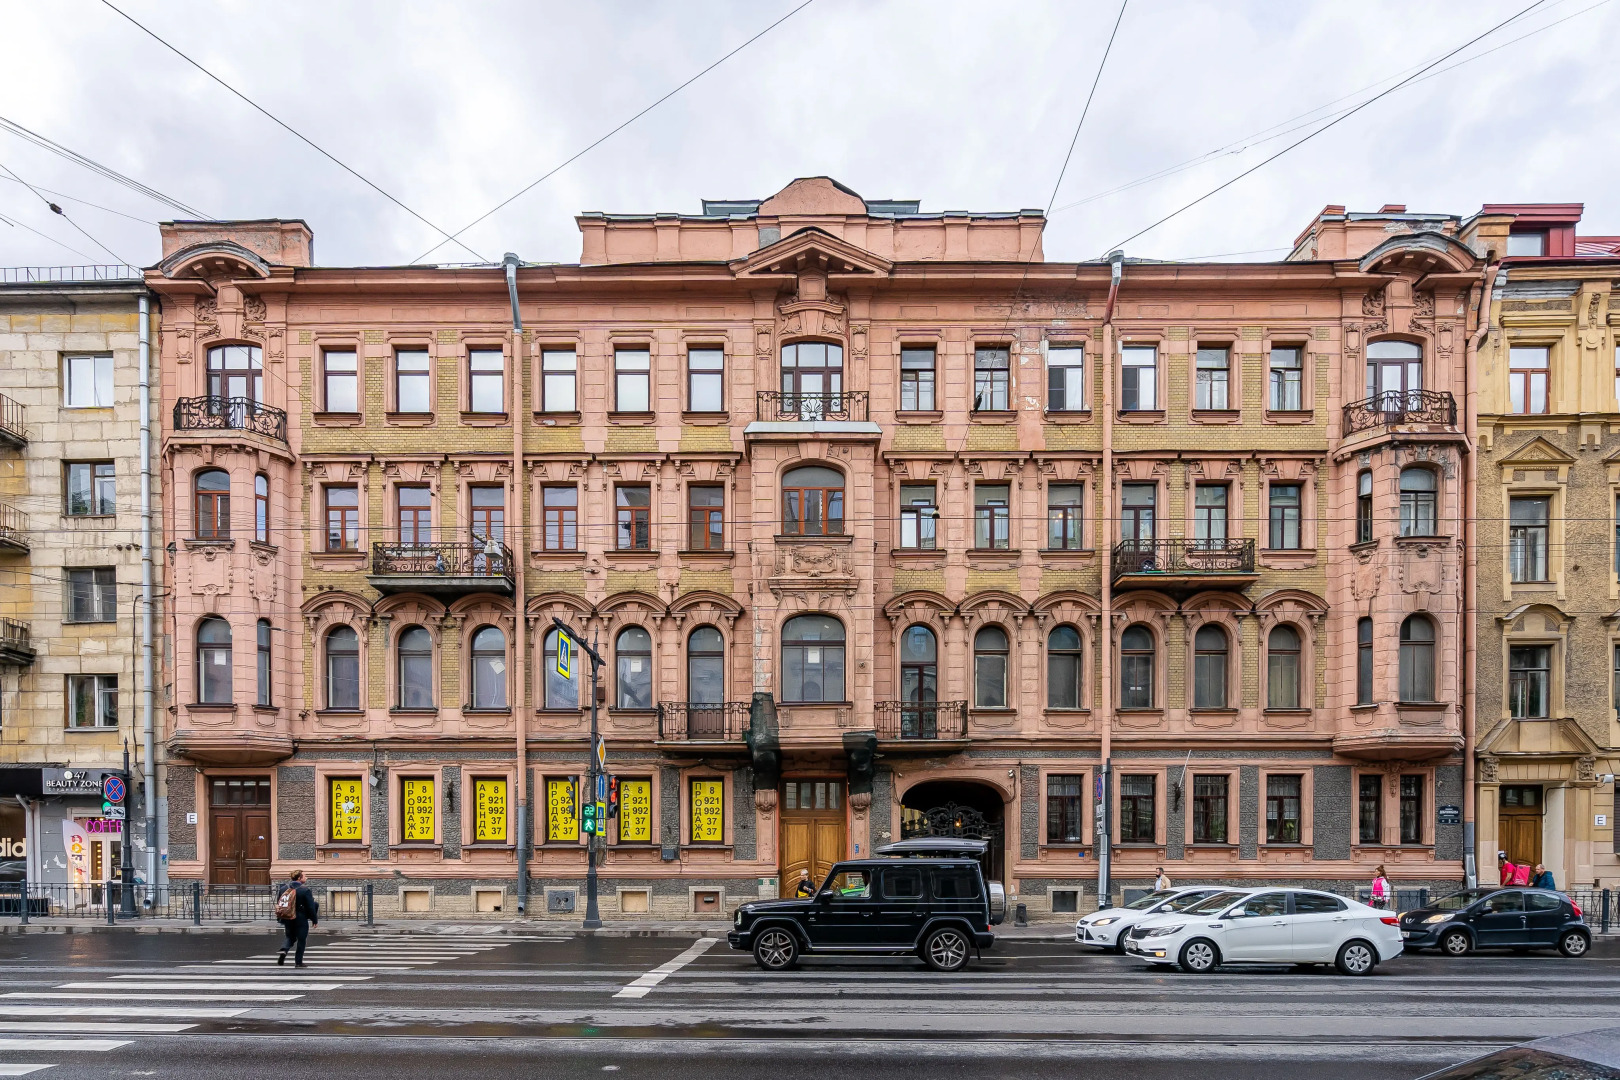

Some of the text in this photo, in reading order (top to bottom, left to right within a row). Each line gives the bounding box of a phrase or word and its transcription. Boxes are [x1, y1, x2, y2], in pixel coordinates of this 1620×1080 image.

[73, 771, 86, 779] 47
[565, 786, 571, 794] 8
[344, 796, 360, 804] 921
[417, 796, 432, 804] 921
[335, 783, 343, 837] АРЕНДА
[345, 806, 360, 814] 92
[407, 782, 416, 839] ПРОДАЖА
[417, 806, 432, 814] 992
[478, 783, 486, 837] АРЕНДА
[551, 782, 560, 839] ПРОДАЖА
[584, 806, 594, 815] 22
[622, 784, 630, 837] АРЕНДА
[694, 783, 703, 839] ПРОДАЖА
[347, 816, 357, 825] 37
[563, 817, 573, 825] 37
[635, 817, 645, 825] 37
[707, 817, 717, 825] 37
[347, 827, 358, 835] 37
[491, 827, 501, 835] 37
[563, 827, 573, 835] 37
